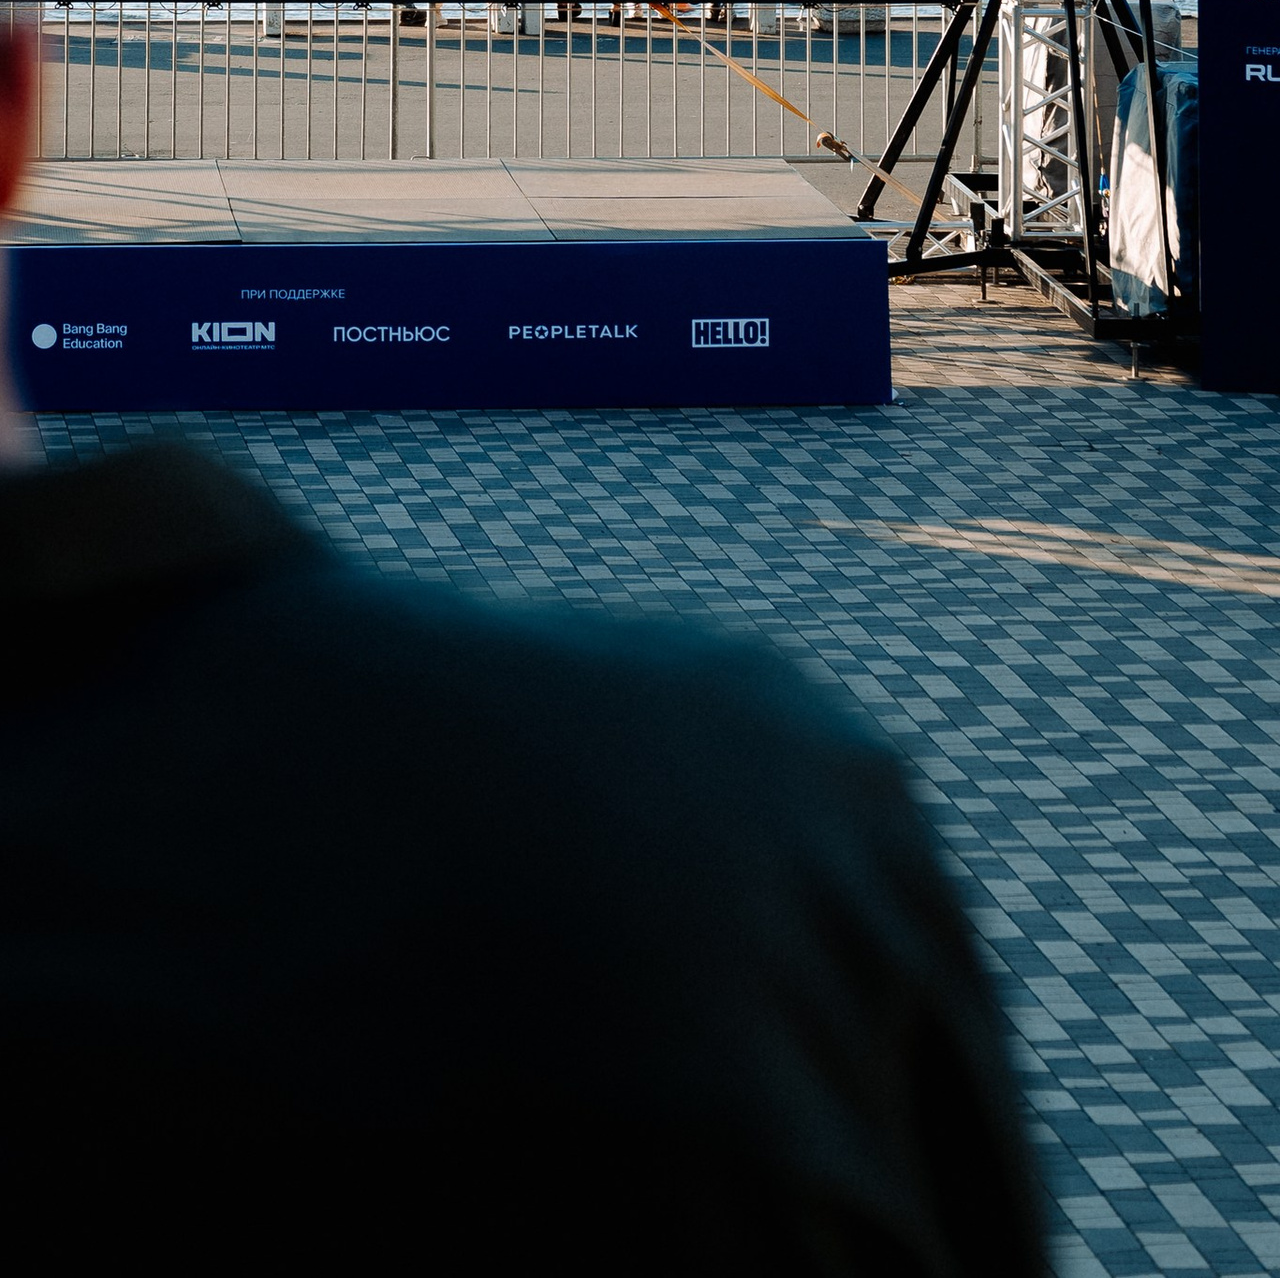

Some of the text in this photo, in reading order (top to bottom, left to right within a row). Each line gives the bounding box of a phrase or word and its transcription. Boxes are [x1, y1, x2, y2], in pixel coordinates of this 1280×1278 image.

[241, 289, 346, 300] ПРИ ПОДДЕРЖКЕ
[63, 323, 128, 337] Bang Bang
[192, 322, 275, 342] KION
[333, 326, 450, 342] ПОСТНЬЮС
[509, 325, 638, 339] PEOPLETALK
[694, 320, 767, 346] HELLO!
[63, 338, 123, 349] Education
